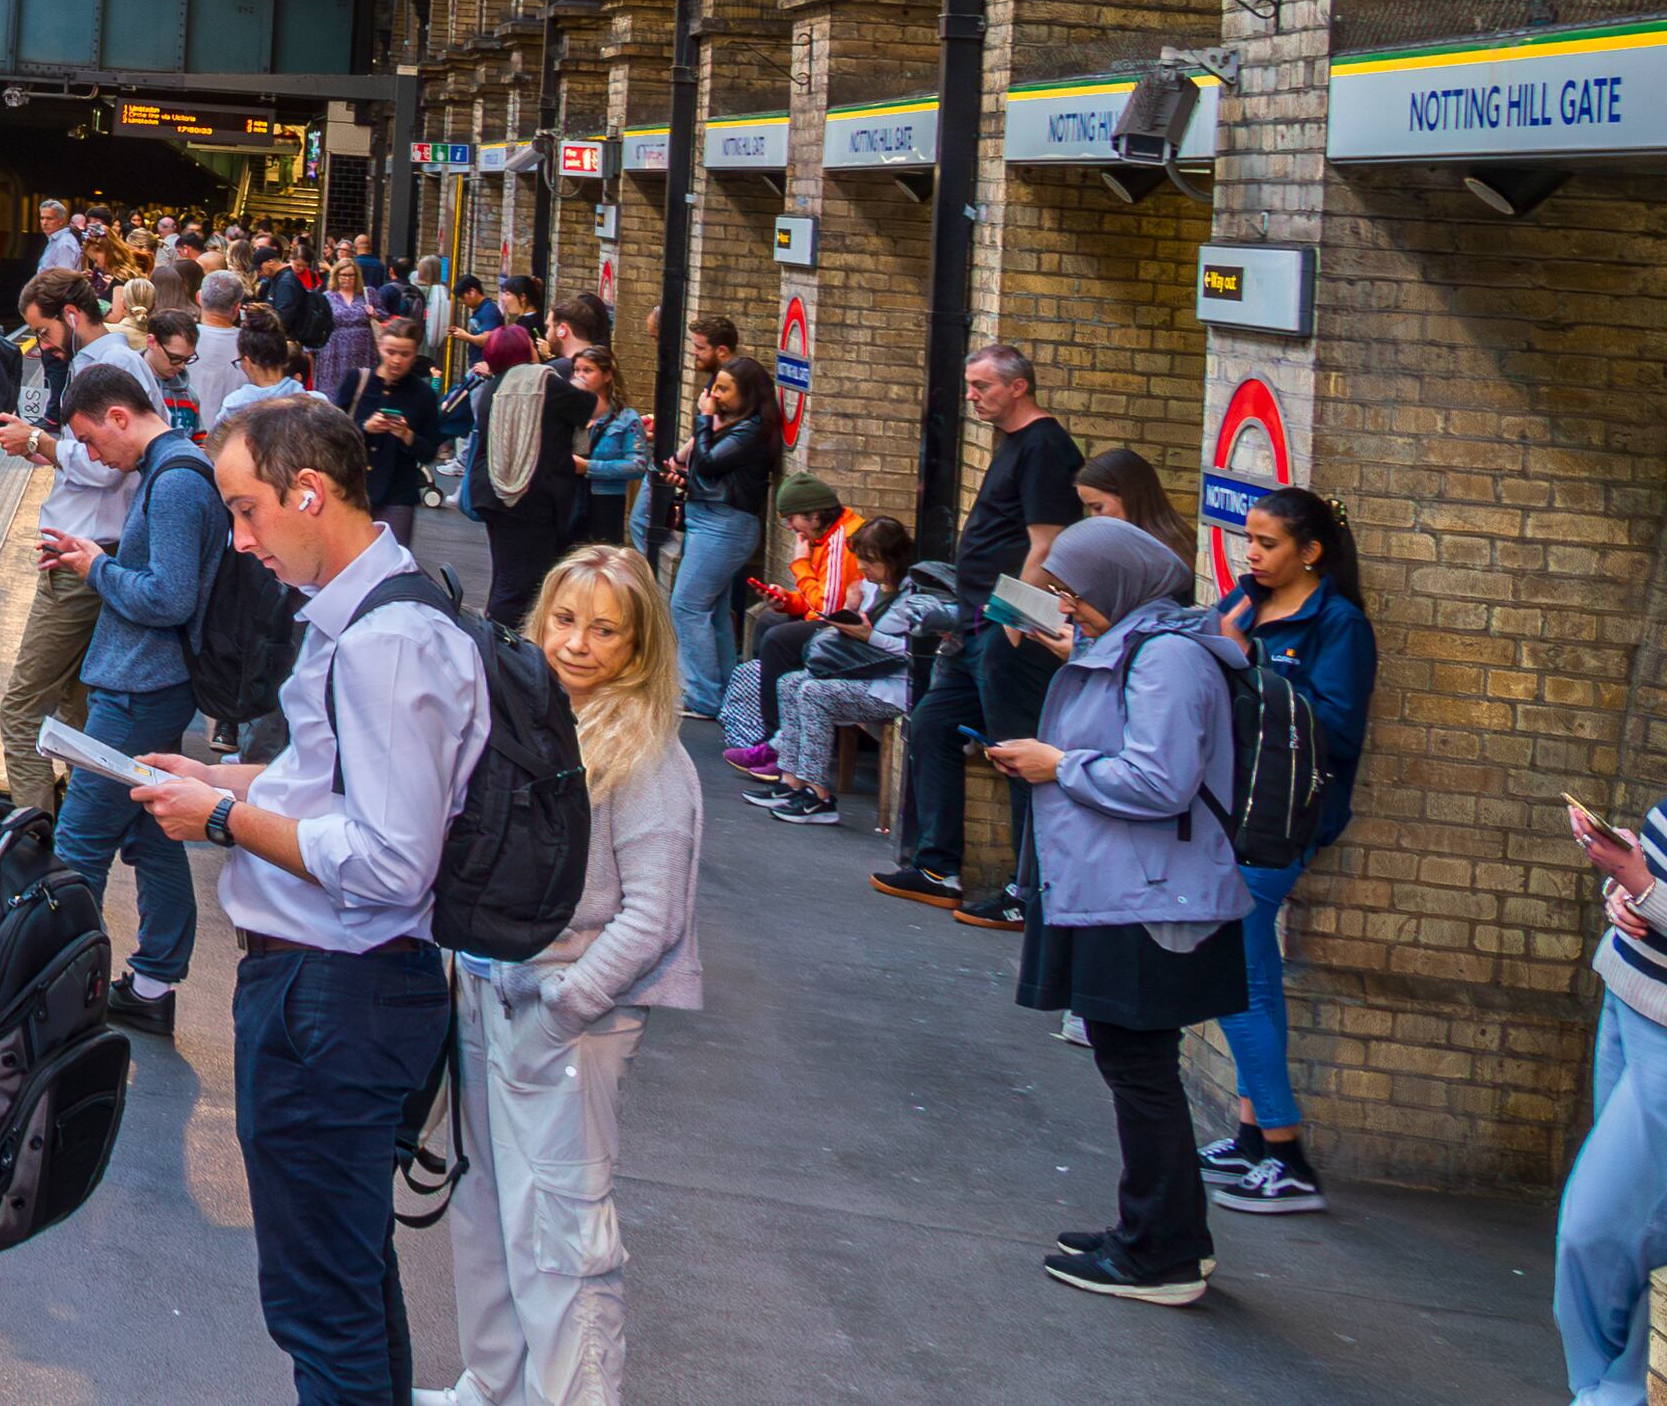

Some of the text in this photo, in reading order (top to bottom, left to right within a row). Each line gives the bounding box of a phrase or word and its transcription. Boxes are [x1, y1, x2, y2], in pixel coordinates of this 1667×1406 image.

[1409, 76, 1622, 131] NOTTING HILL GATE
[849, 129, 878, 152] NOTTING
[894, 126, 913, 150] GATE
[1048, 112, 1095, 143] NOTTING
[565, 148, 577, 157] Fire
[1210, 271, 1237, 293] Way out
[1206, 484, 1247, 516] NOTTING
